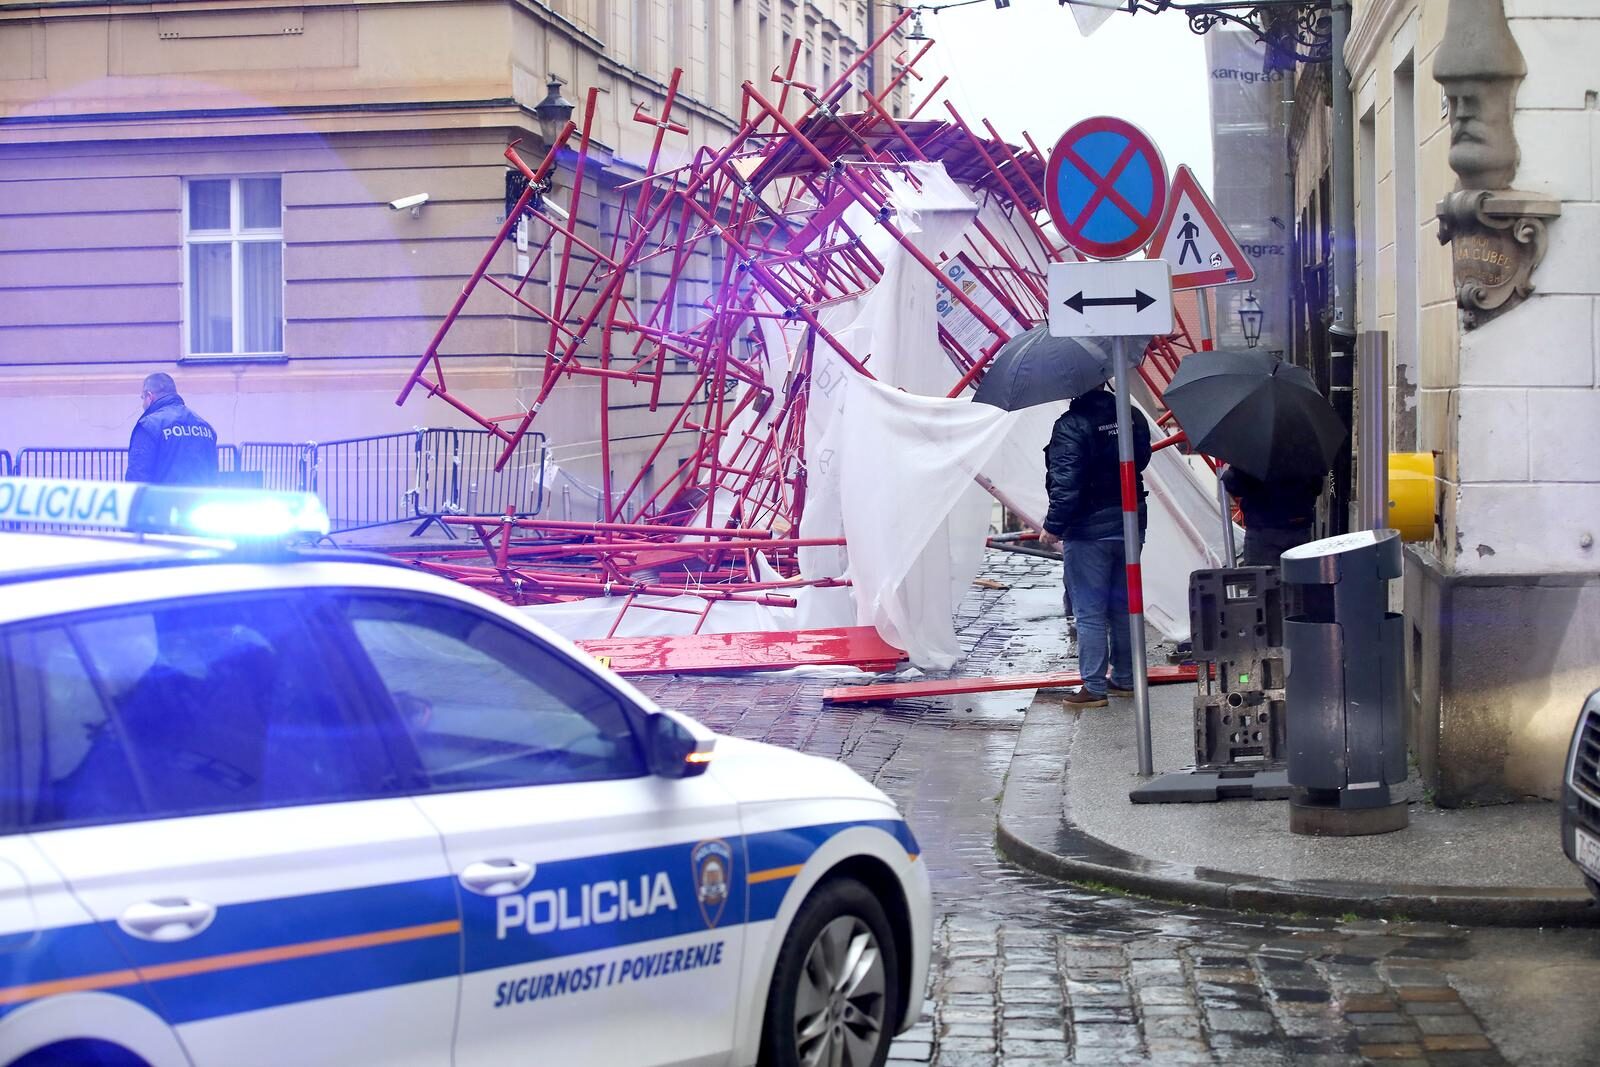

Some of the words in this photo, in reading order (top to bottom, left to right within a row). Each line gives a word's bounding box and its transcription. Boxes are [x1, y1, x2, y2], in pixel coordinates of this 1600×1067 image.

[496, 871, 678, 940] POLICIJA
[494, 962, 604, 1009] SIGURNOST
[607, 961, 617, 986] I
[618, 940, 725, 985] POVJERENJE
